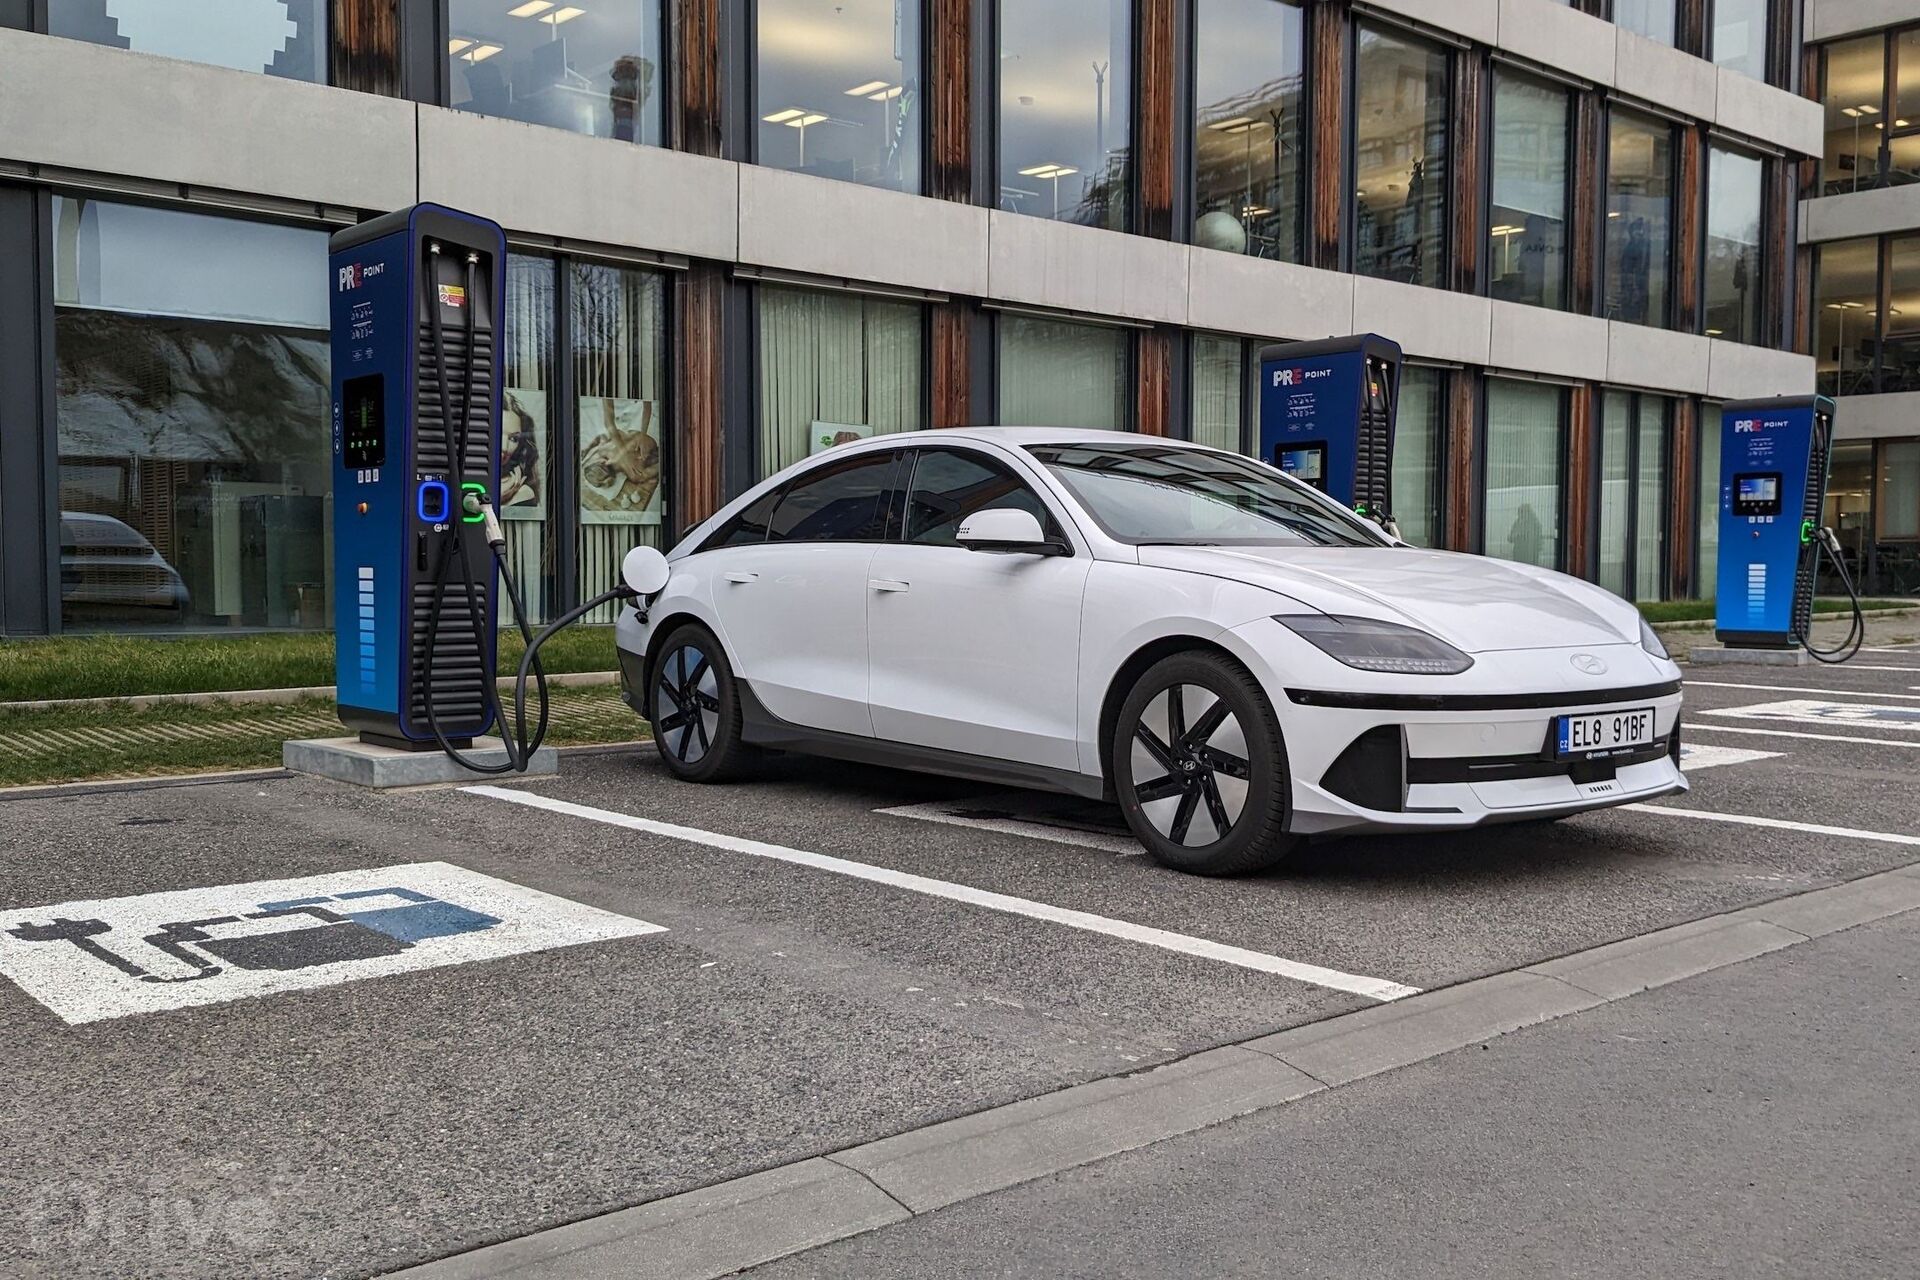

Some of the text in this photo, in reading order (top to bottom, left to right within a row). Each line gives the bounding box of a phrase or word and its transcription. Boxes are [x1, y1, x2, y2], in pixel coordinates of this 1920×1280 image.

[339, 262, 384, 291] PRE POINT
[1273, 369, 1331, 386] PRE POINT
[1735, 420, 1761, 432] PRE
[1572, 714, 1647, 747] EL8 91BF
[1560, 740, 1568, 749] CZ
